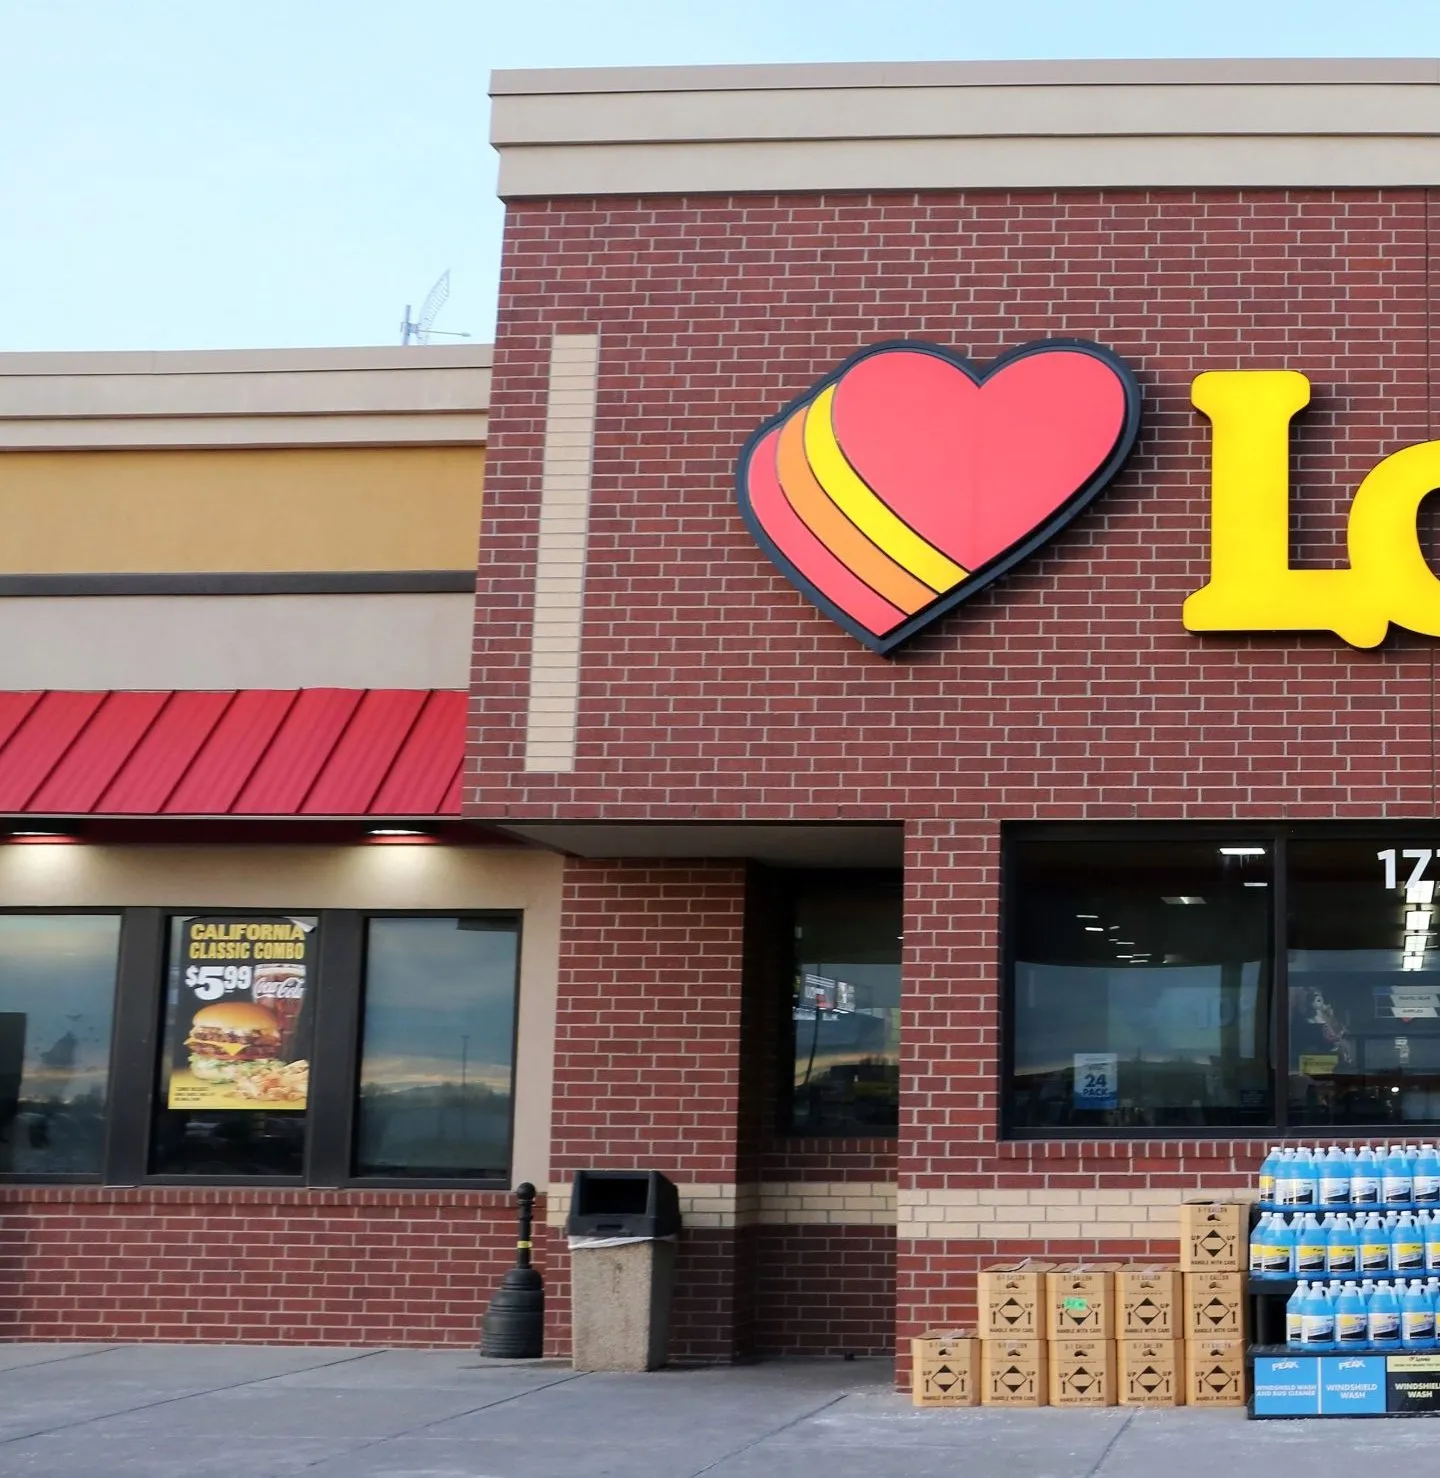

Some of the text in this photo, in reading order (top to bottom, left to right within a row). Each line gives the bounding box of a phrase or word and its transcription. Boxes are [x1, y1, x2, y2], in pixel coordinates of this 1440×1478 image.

[190, 923, 306, 940] CALIFORNIA
[189, 942, 305, 959] CLASSIC COMBO
[1084, 1074, 1108, 1088] 24
[1326, 1383, 1378, 1391] WINDSHIELD
[1341, 1391, 1366, 1399] WASH
